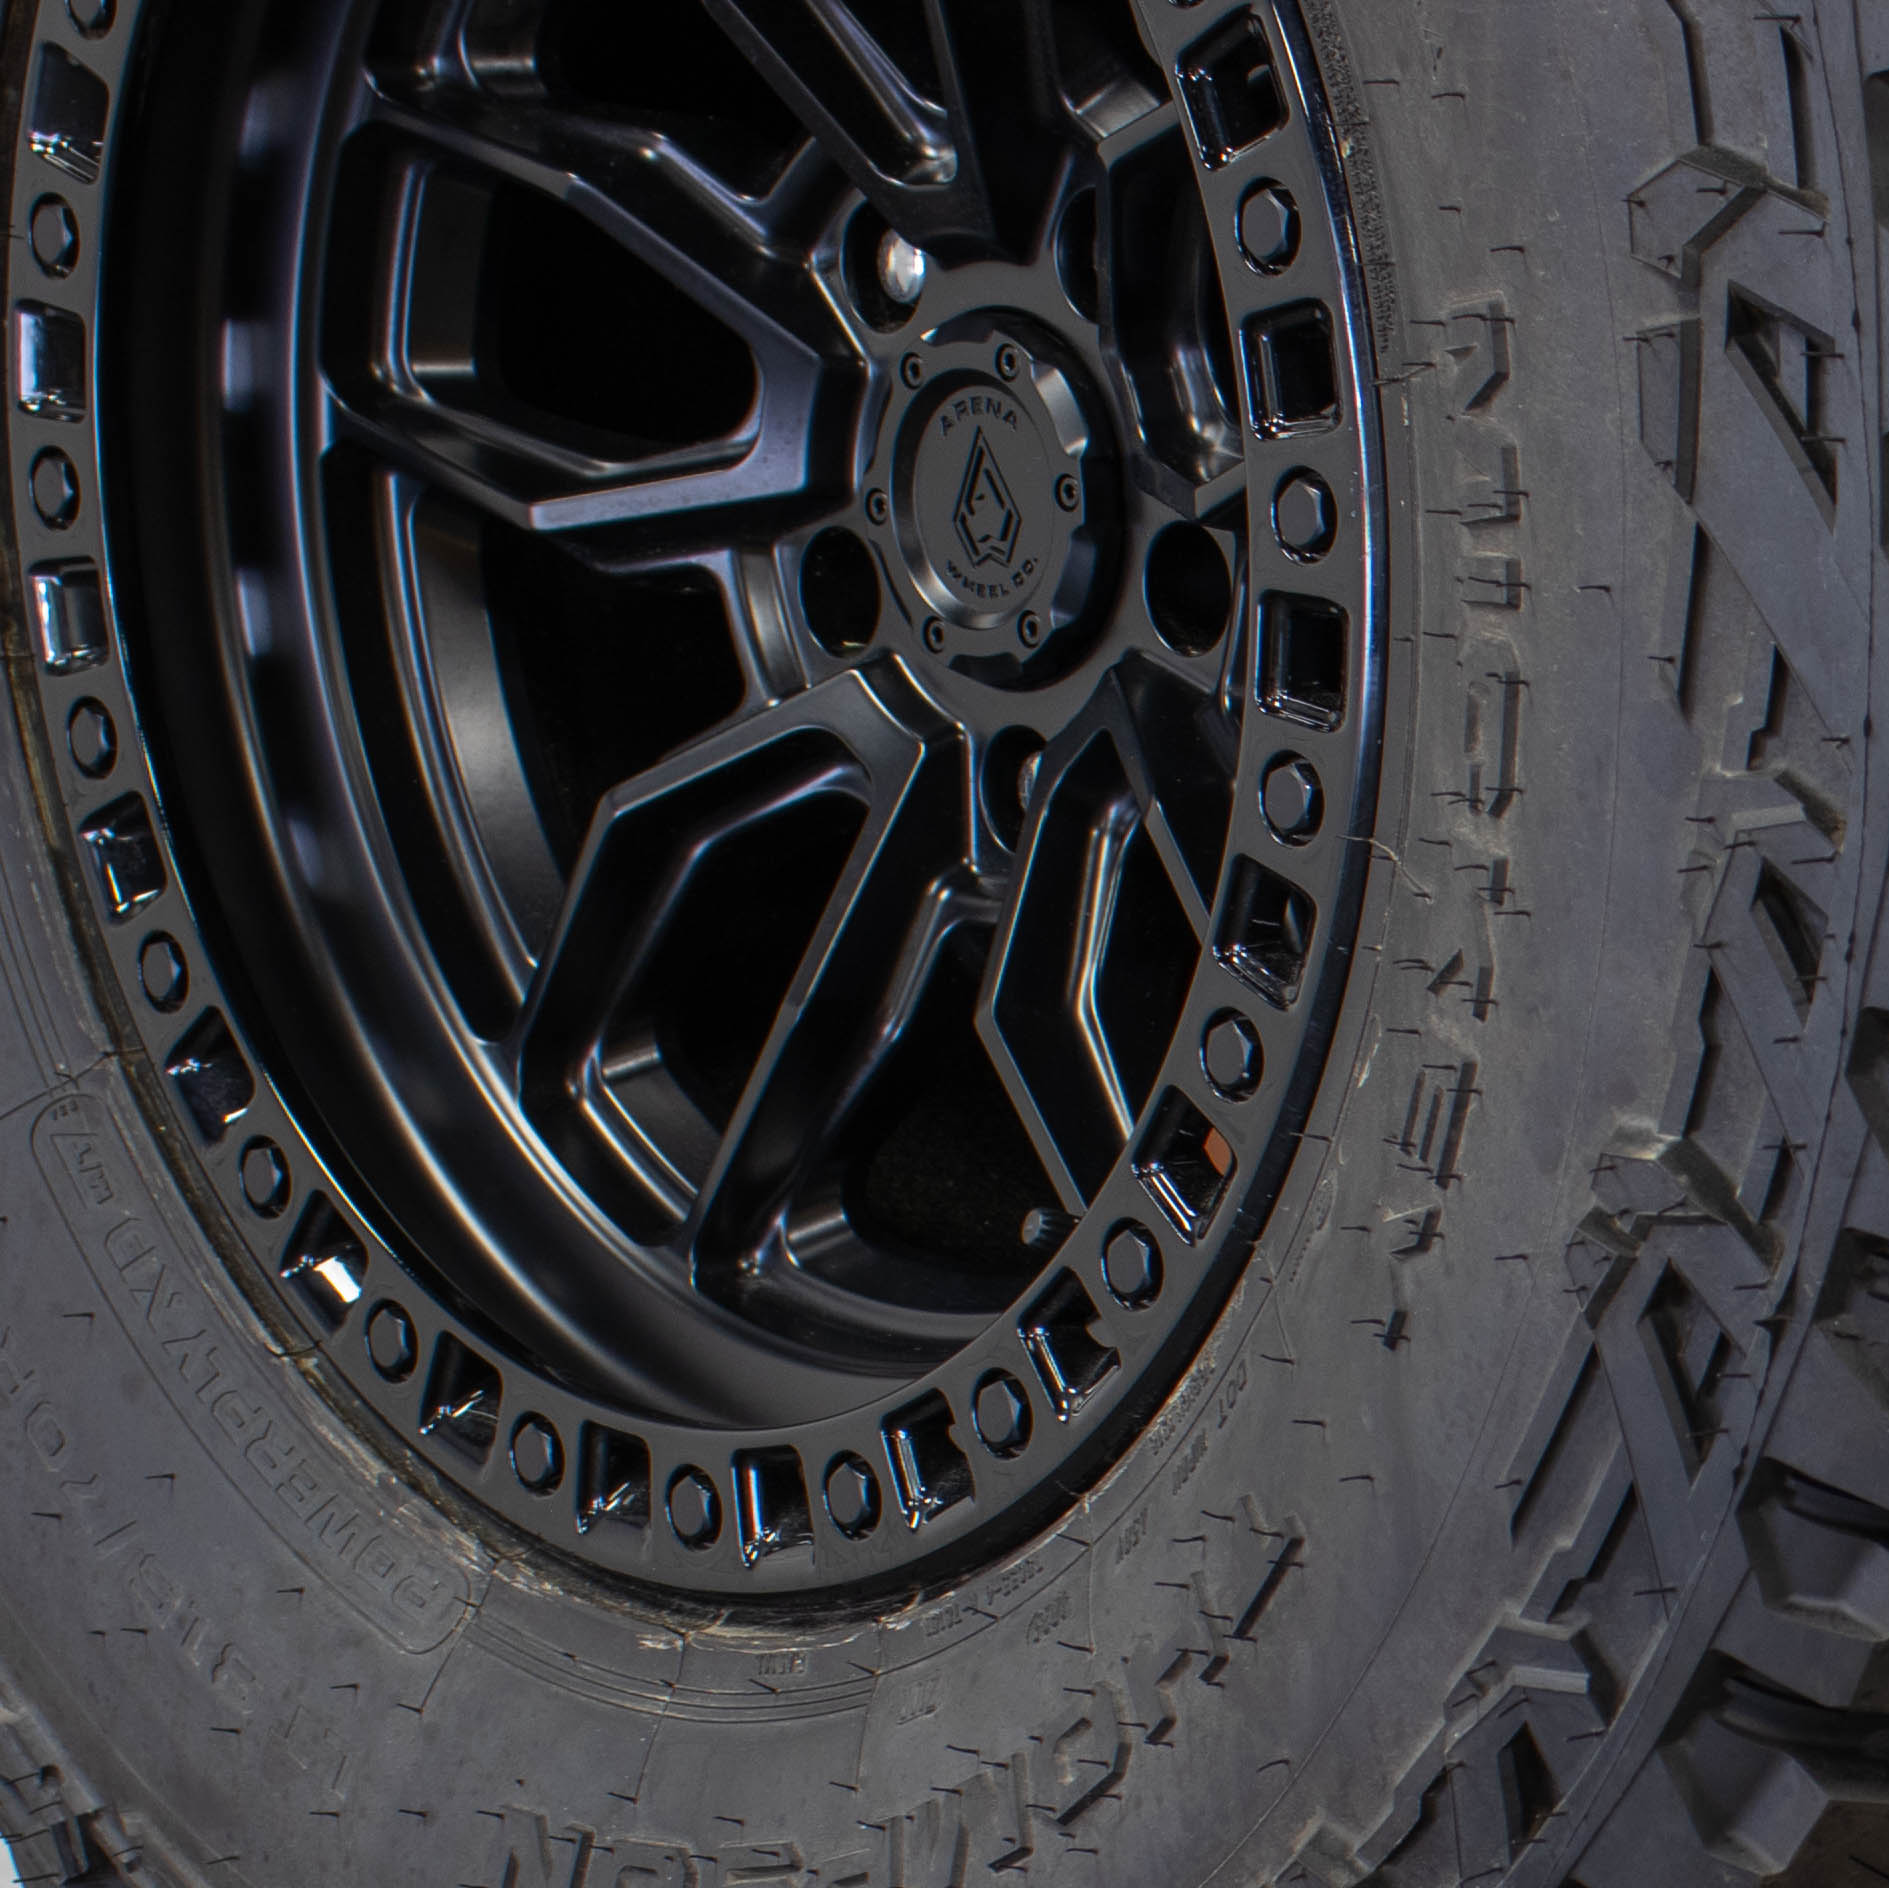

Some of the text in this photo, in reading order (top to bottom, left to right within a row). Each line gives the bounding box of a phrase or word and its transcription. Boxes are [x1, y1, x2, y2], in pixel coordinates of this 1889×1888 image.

[940, 396, 1017, 436] ARENA
[946, 559, 1010, 599] WHEEL
[1384, 292, 1522, 1348] MICKEY
[1218, 1358, 1247, 1429] DOT
